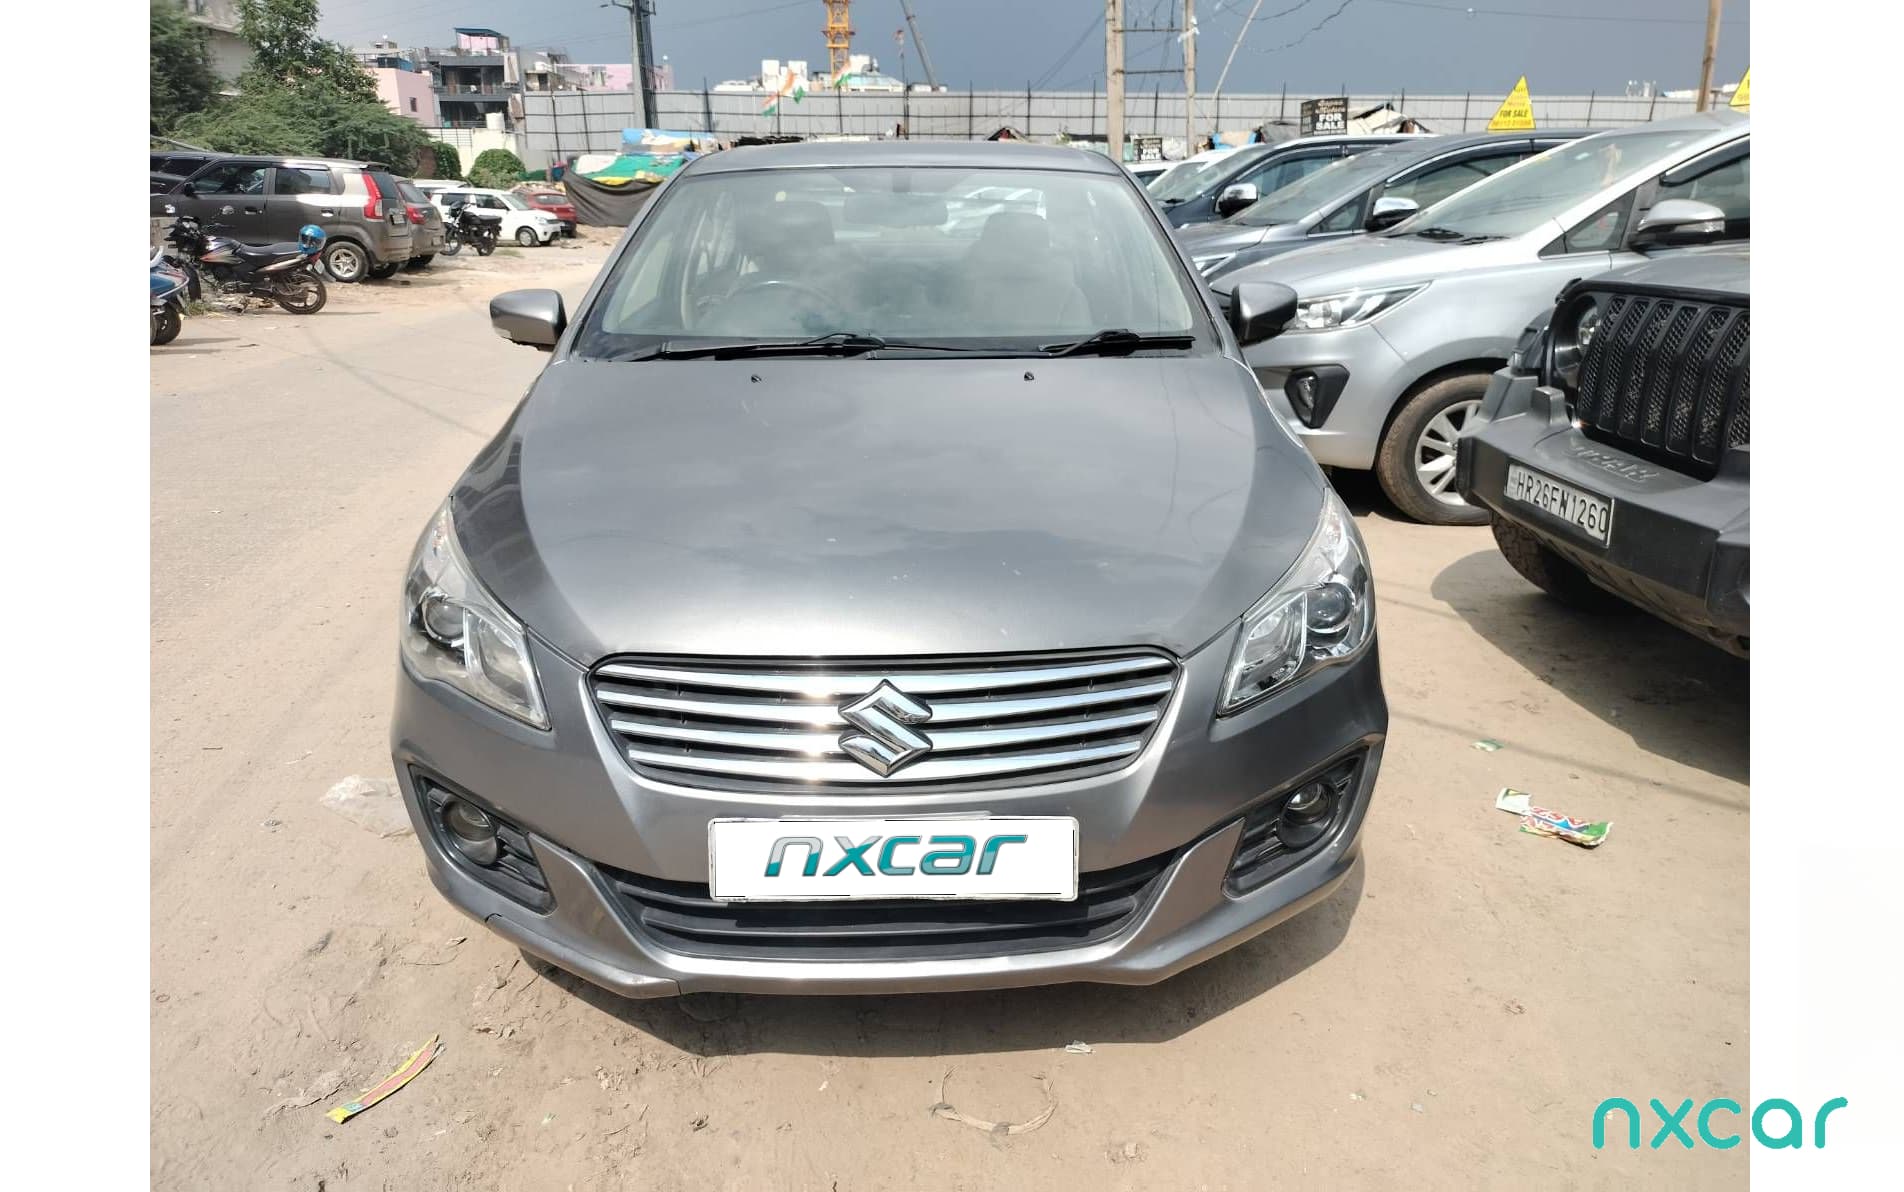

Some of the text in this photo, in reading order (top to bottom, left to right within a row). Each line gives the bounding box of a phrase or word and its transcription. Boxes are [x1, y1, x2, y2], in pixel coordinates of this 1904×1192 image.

[1319, 113, 1343, 122] FOR
[1500, 109, 1529, 118] FOR SALE
[1315, 121, 1345, 130] SALE
[1517, 471, 1608, 533] HR26FN1260
